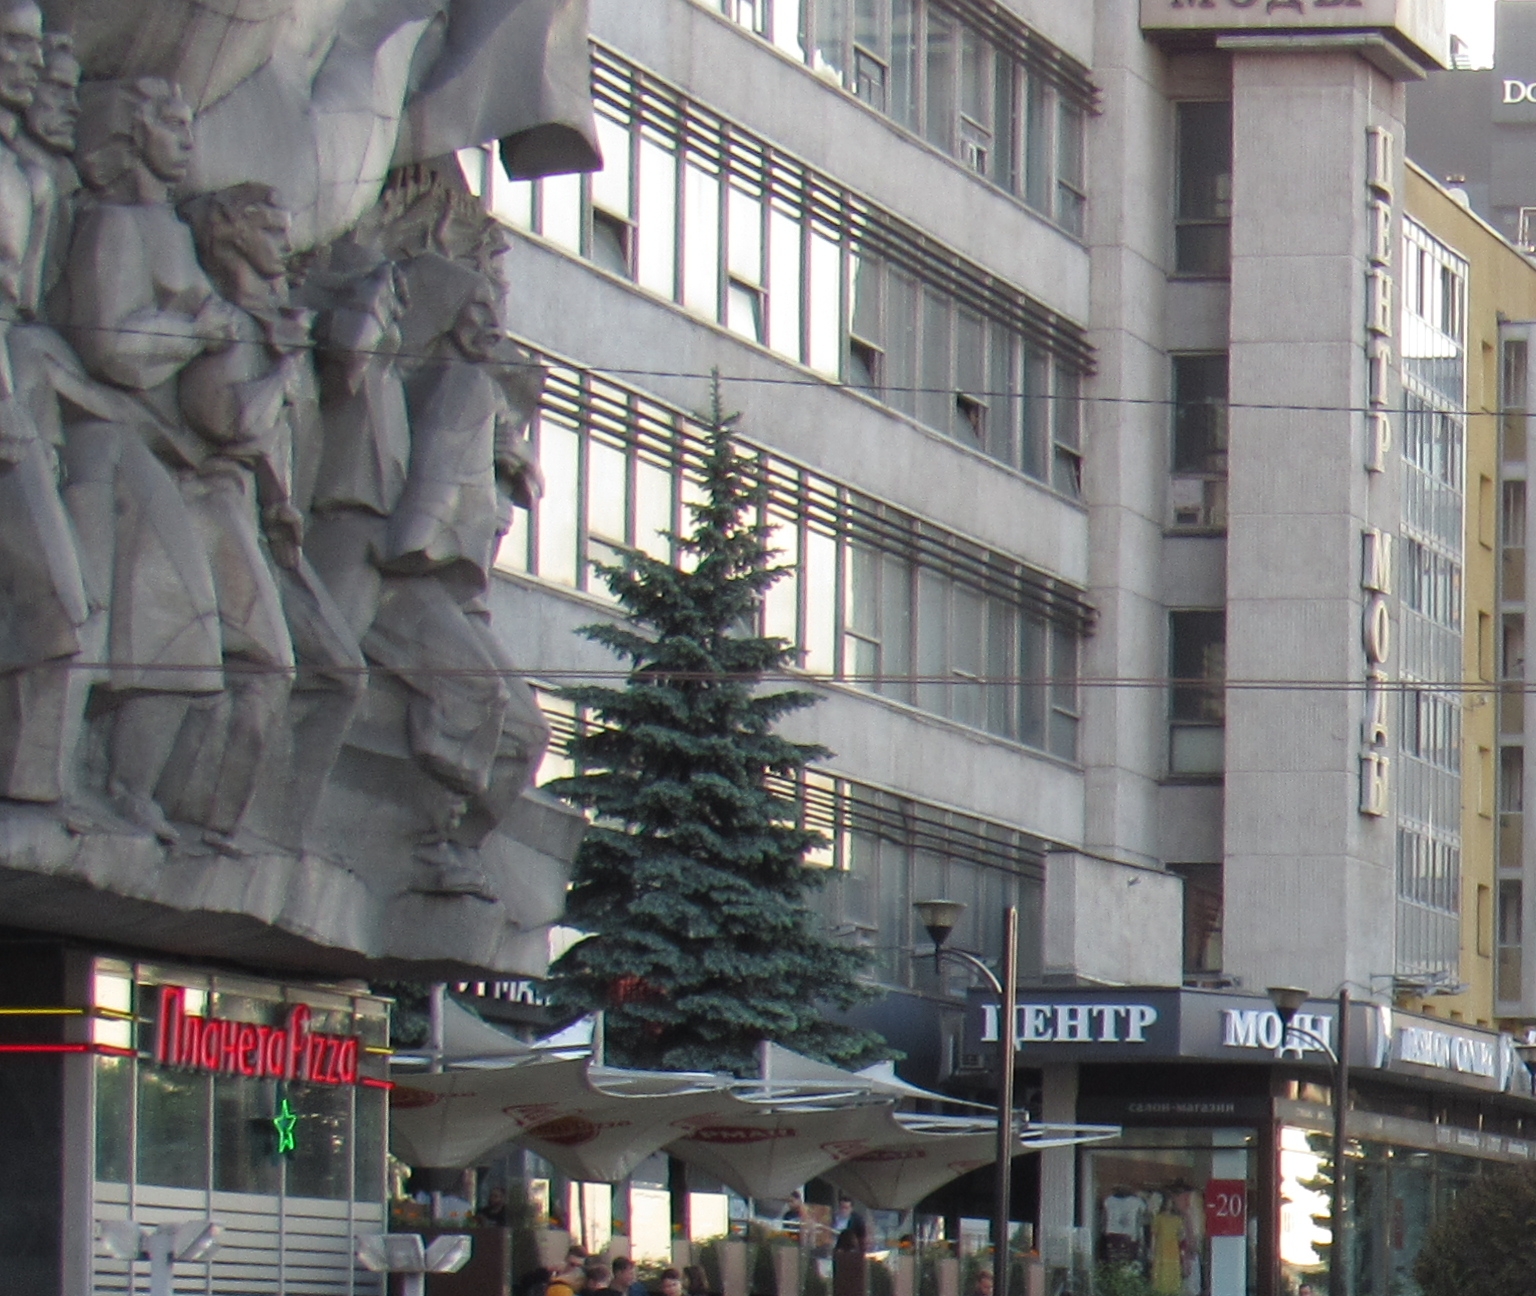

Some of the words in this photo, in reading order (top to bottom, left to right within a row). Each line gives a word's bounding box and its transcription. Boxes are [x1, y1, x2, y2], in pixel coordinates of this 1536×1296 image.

[1365, 125, 1394, 473] ЦЕНТР
[1359, 527, 1392, 817] МОДЫ
[157, 984, 287, 1077] Планета
[285, 1003, 359, 1084] Pizza
[1222, 1009, 1333, 1060] МОДЫ
[1128, 1104, 1235, 1114] салон-магазин
[1207, 1193, 1242, 1217] -20
